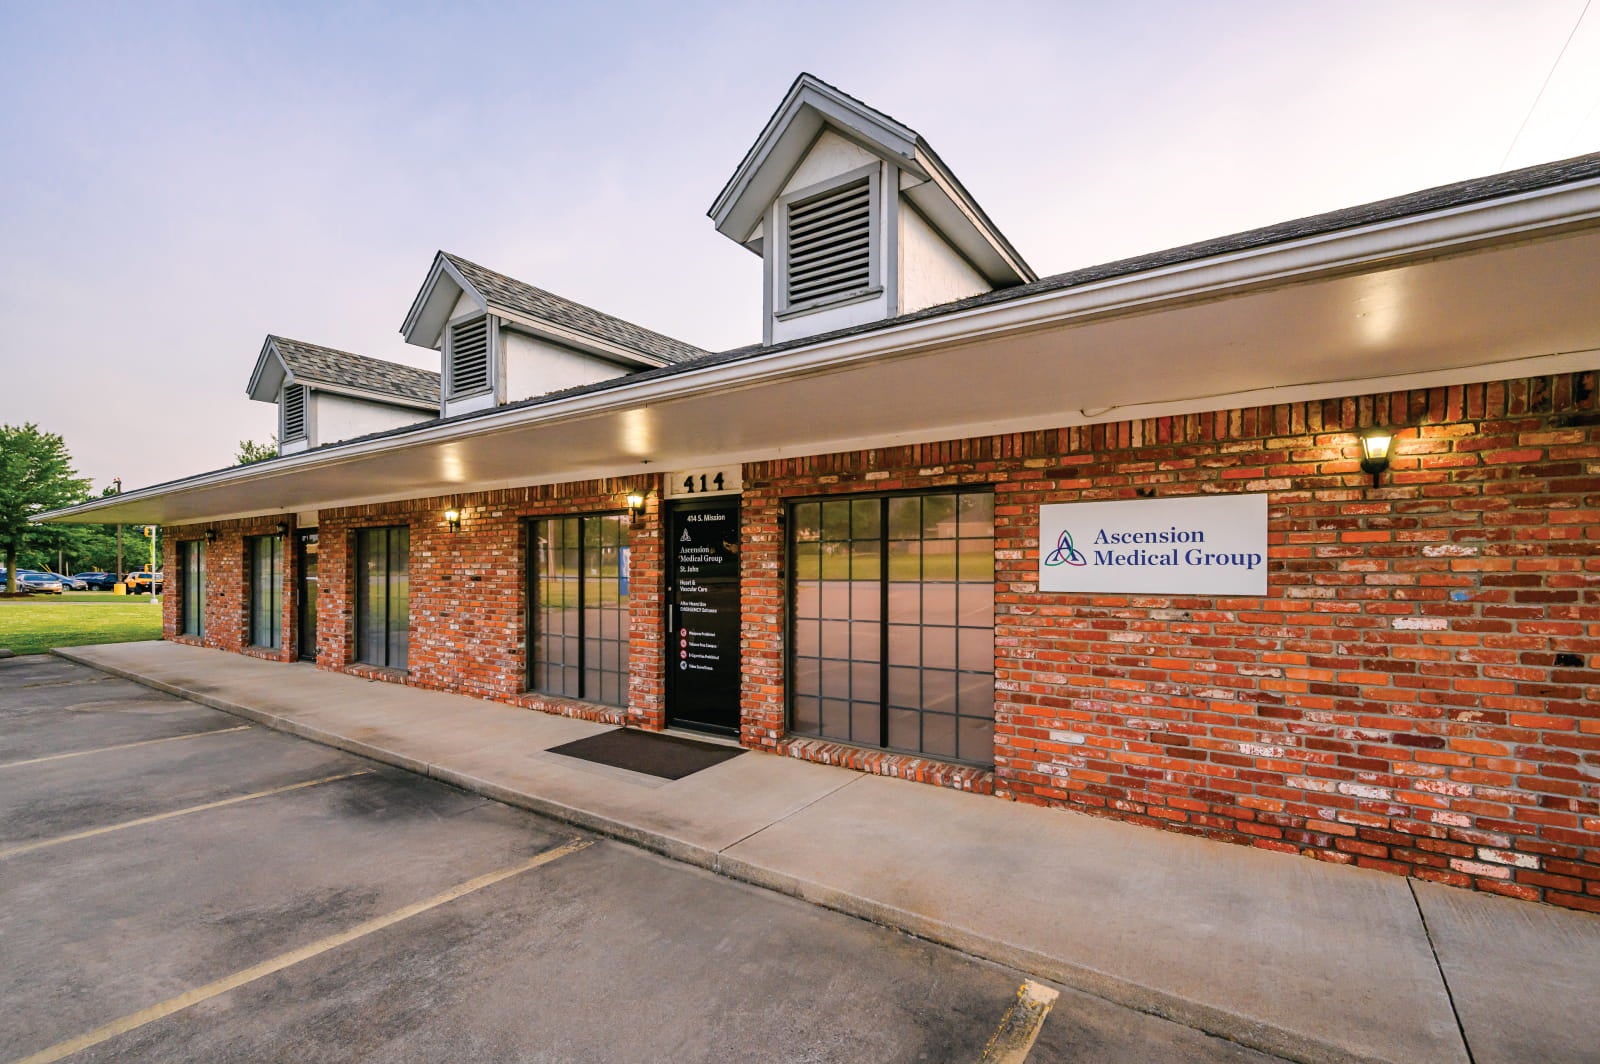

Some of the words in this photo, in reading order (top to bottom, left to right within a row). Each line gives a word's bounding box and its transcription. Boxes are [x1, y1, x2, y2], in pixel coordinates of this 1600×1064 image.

[684, 472, 724, 493] 414
[1093, 526, 1205, 545] Ascension
[680, 546, 710, 554] Ascension
[680, 554, 703, 562] Medical
[704, 554, 723, 564] Group
[1093, 549, 1179, 566] Medical
[1184, 548, 1263, 570] Group
